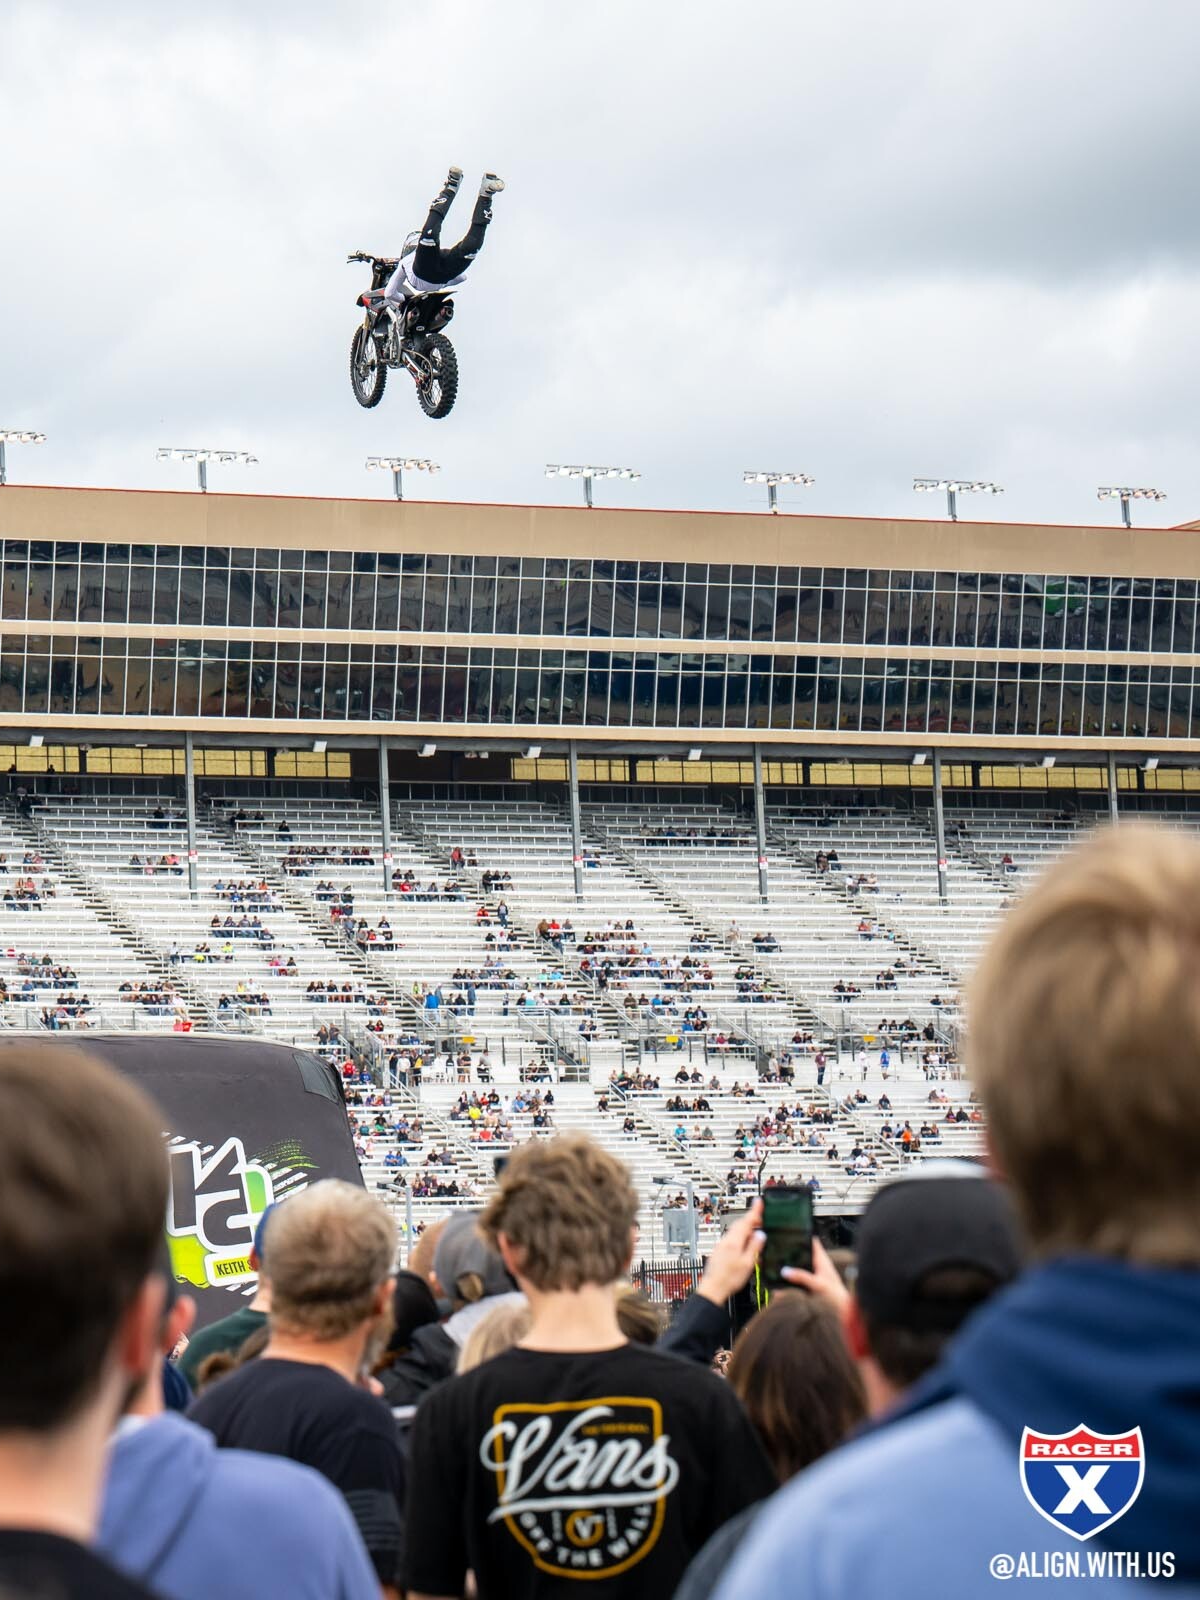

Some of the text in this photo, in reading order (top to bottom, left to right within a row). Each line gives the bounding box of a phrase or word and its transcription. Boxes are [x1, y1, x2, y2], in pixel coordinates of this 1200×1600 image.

[216, 1261, 246, 1275] KEITH
[480, 1405, 680, 1525] Vans
[557, 1546, 603, 1567] THE
